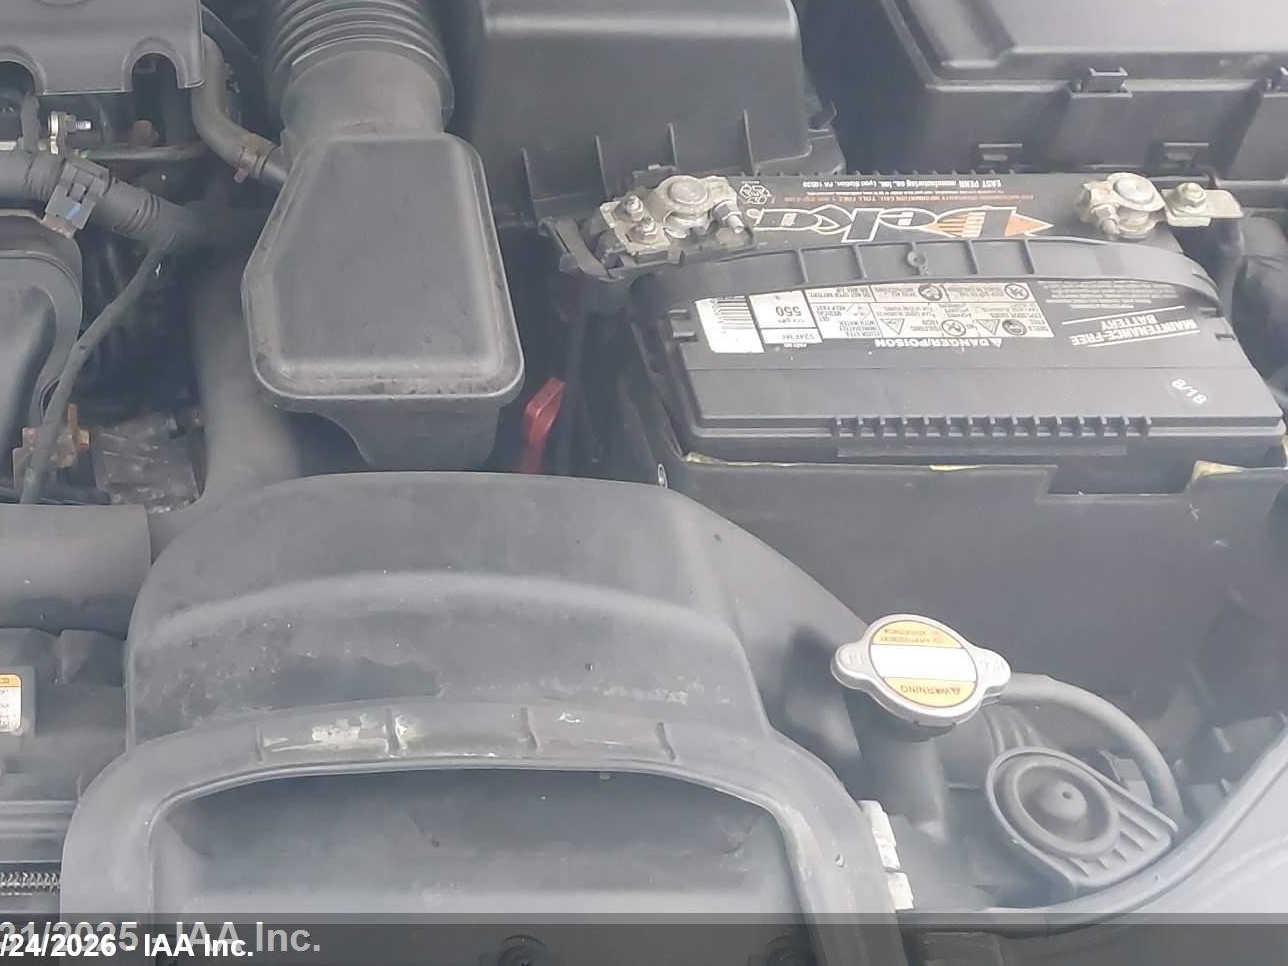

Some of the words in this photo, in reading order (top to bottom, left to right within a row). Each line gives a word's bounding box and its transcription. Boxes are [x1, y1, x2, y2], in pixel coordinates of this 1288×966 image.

[775, 306, 802, 317] 550
[1100, 313, 1158, 331] BATTERY
[1069, 318, 1199, 346] MAINTENANCE-FREE
[874, 337, 991, 347] DANGER/POISON
[1171, 378, 1208, 405] 8/18
[899, 685, 952, 696] WARNING
